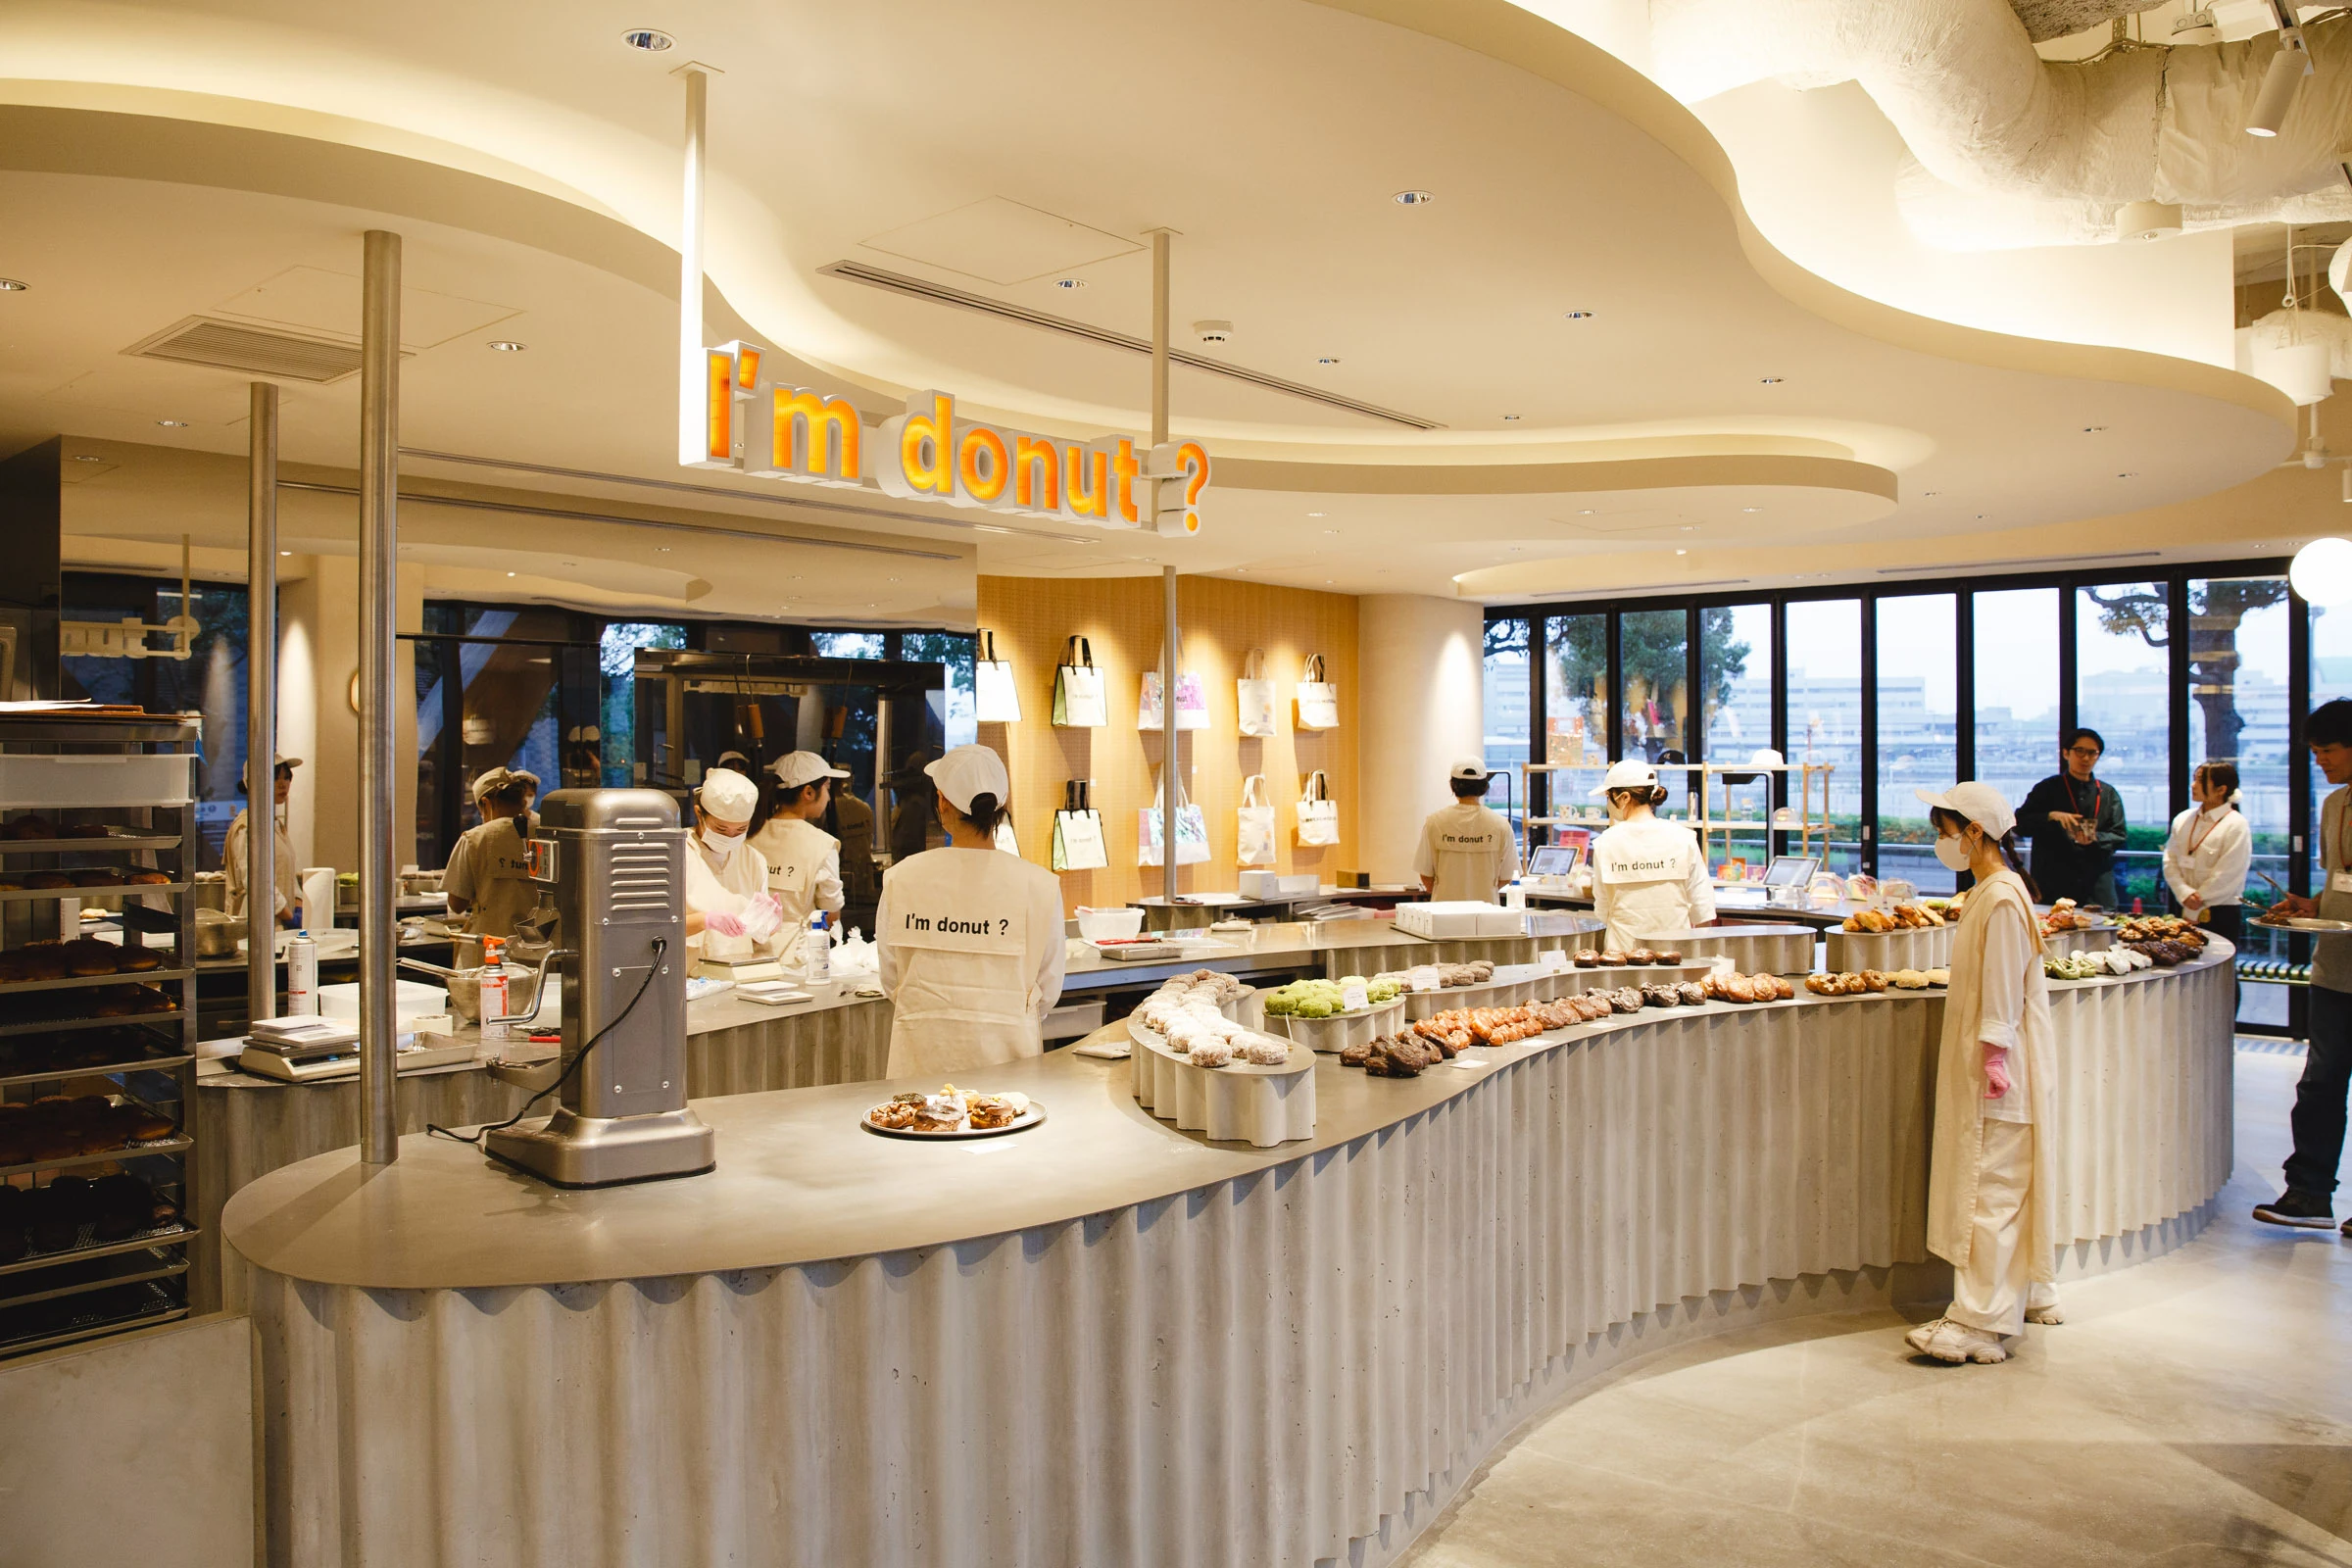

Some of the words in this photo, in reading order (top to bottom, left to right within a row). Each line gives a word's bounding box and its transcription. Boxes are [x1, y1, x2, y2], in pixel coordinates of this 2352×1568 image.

[706, 339, 863, 484] I'm
[896, 389, 1141, 529] donut
[1173, 440, 1211, 537] ?
[1442, 833, 1455, 842] I'm
[1458, 835, 1484, 844] donut
[1487, 834, 1493, 843] ?
[767, 865, 781, 875] ut
[787, 865, 795, 877] ?
[1611, 861, 1628, 872] I'm
[1632, 859, 1664, 871] donut
[1670, 858, 1676, 868] ?
[906, 912, 931, 931] I'm
[937, 916, 989, 935] donut
[999, 918, 1008, 936] ?
